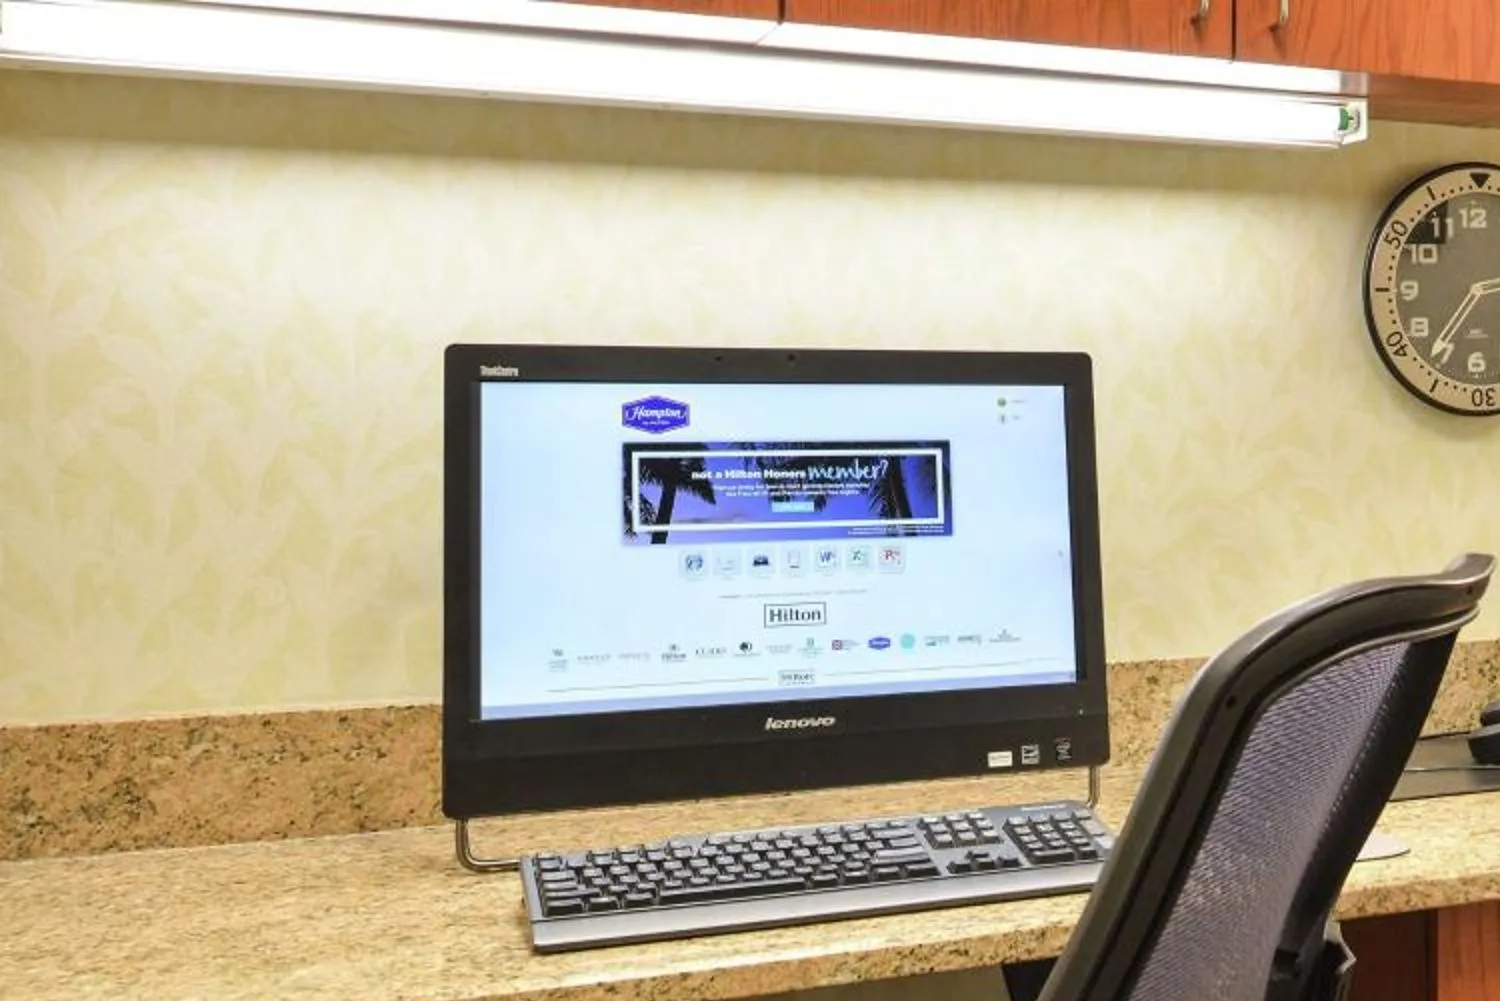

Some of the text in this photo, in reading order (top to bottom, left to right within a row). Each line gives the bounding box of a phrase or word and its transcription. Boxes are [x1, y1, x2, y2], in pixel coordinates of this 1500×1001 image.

[1431, 217, 1454, 238] 11
[1459, 208, 1487, 229] 12
[1383, 220, 1408, 249] 50
[1409, 244, 1438, 264] 10
[1400, 280, 1419, 300] 9
[1410, 317, 1429, 337] 8
[1385, 331, 1409, 359] 40
[1467, 352, 1486, 373] 6
[1471, 387, 1497, 407] 30
[627, 405, 684, 421] Hampton
[691, 469, 713, 480] not
[725, 468, 762, 480] Hilton
[763, 468, 807, 480] Honors
[808, 458, 889, 481] member?
[769, 608, 823, 623] Hilton
[764, 715, 837, 731] lenovo
